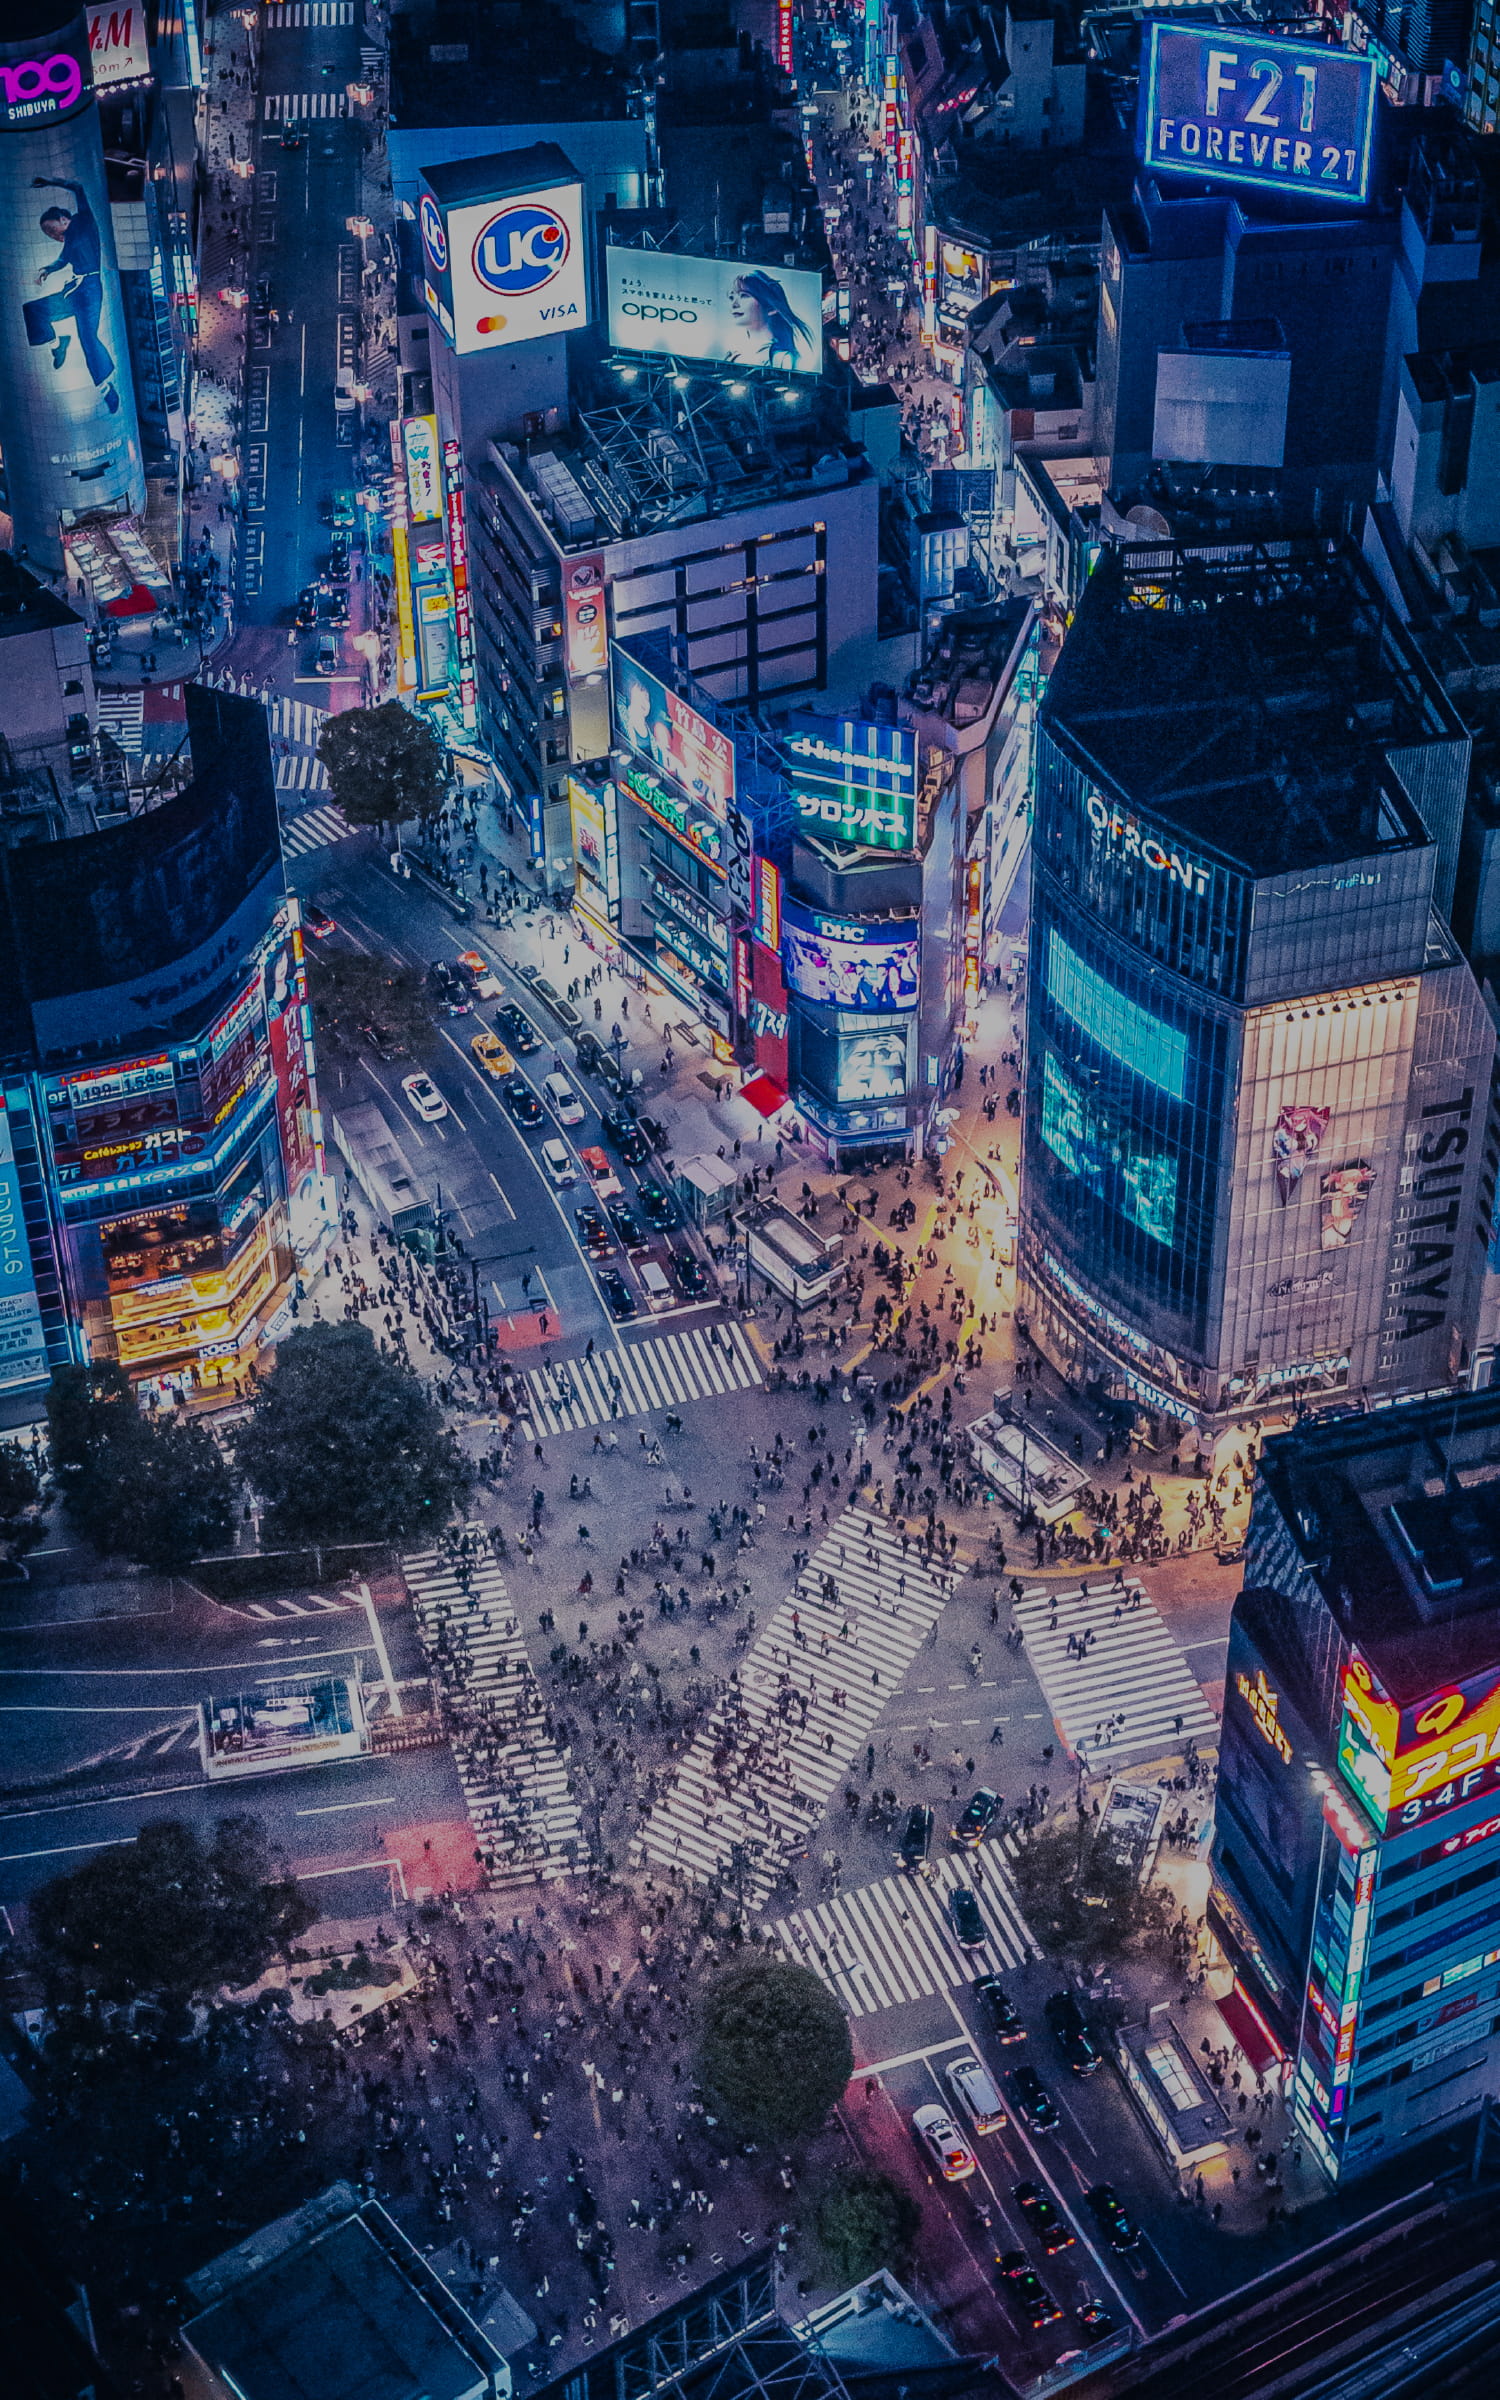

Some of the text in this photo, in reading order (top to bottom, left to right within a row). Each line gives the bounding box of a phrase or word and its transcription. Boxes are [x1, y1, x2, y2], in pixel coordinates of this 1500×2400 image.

[0, 53, 82, 109] 109
[8, 98, 56, 120] SHIBUYA
[1159, 118, 1357, 181] FOREVER 21
[483, 222, 562, 275] UC
[540, 303, 577, 322] VISA
[796, 794, 908, 837] サロンパス
[821, 921, 866, 943] DHC
[48, 1091, 68, 1104] 9F
[58, 1168, 82, 1182] 7F
[1396, 1086, 1475, 1341] TSUTAYA
[1126, 1371, 1197, 1426] TSUTAYA
